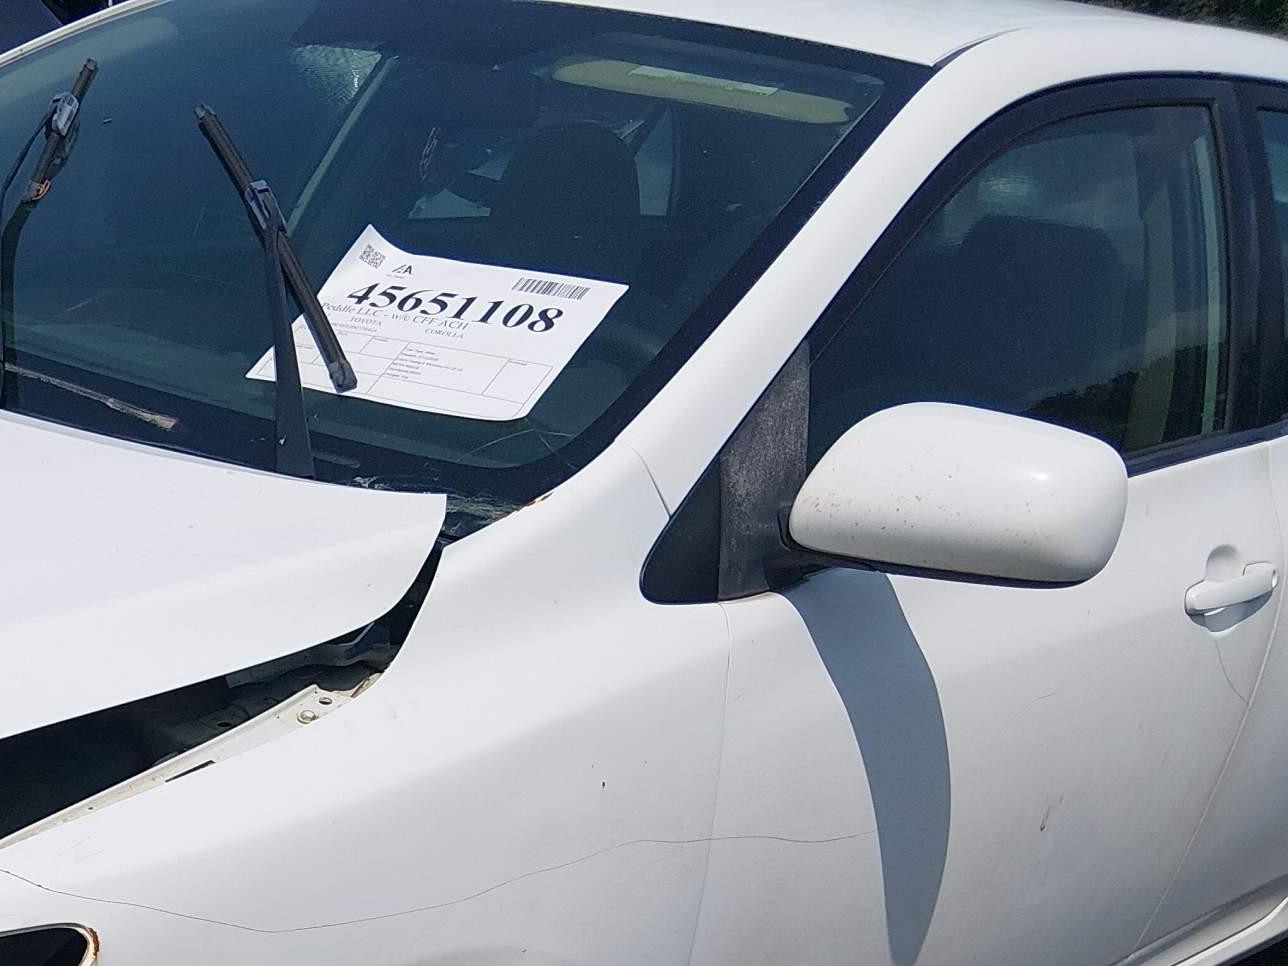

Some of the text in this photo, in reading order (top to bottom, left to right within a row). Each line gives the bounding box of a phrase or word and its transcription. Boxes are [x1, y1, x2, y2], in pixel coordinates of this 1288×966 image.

[322, 302, 357, 314] Peddle
[357, 307, 382, 317] LLC
[440, 319, 469, 331] ACH
[347, 282, 564, 334] 45651108
[350, 316, 382, 326] TOYOTA
[424, 328, 464, 339] COROLLA
